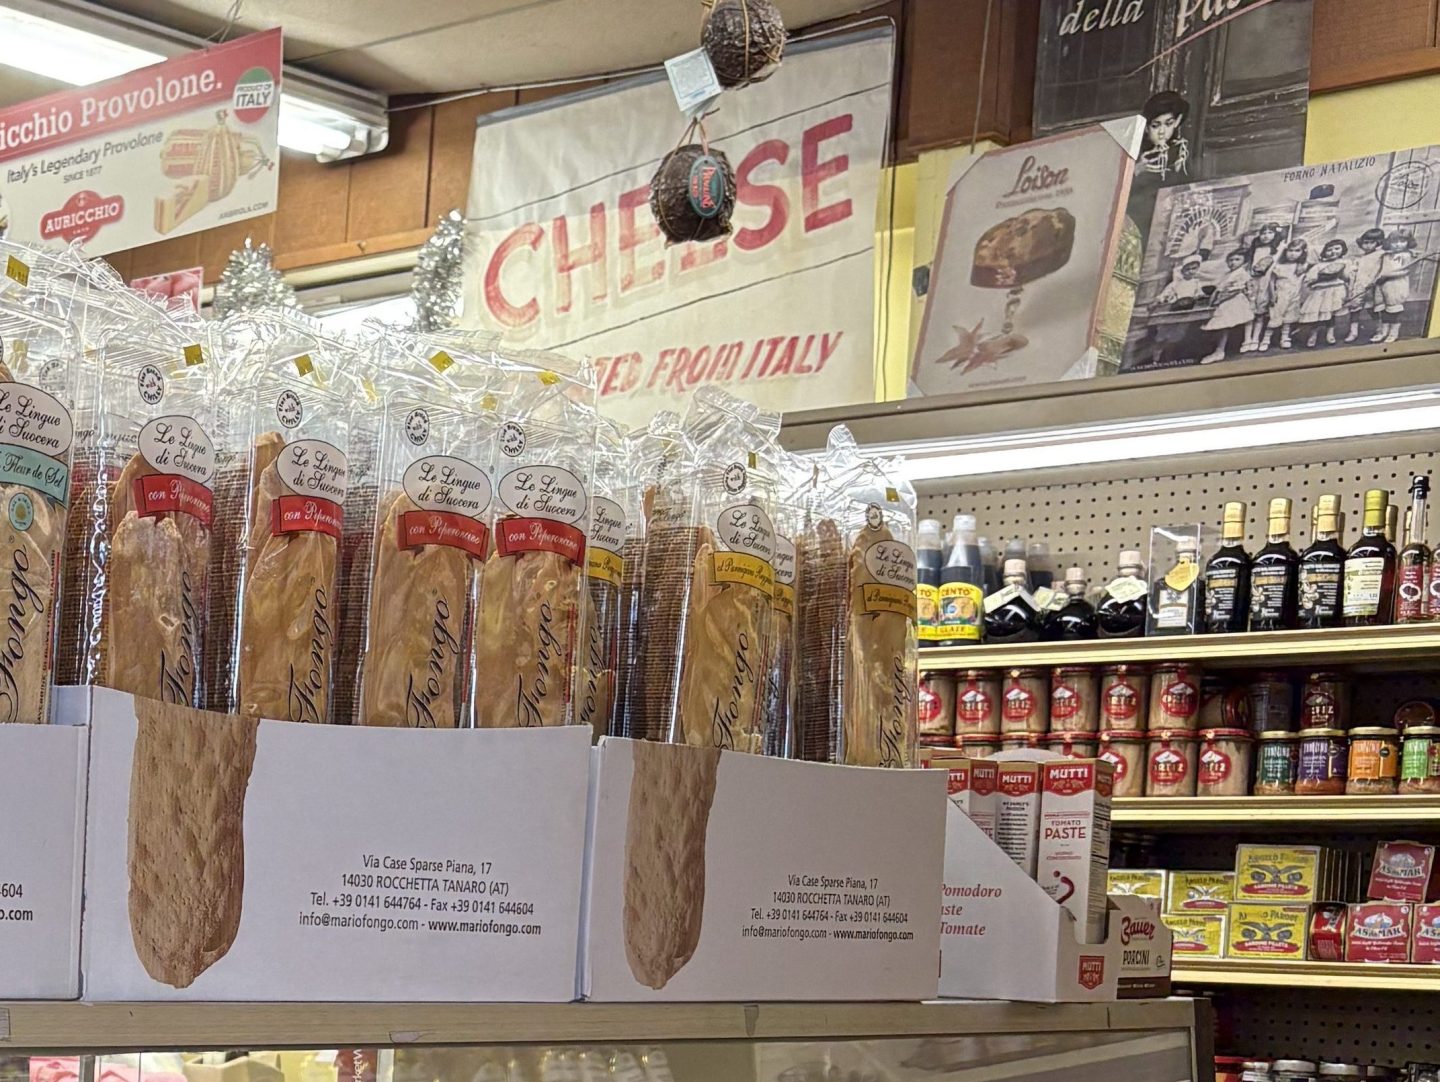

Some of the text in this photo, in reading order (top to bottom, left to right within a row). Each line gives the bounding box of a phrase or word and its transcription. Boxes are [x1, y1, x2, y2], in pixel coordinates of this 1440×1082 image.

[80, 69, 222, 126] Provolone.
[235, 91, 272, 108] ITALY
[7, 130, 164, 184] Italy's Legendary Provolone
[63, 172, 84, 184] SINCE
[1002, 155, 1069, 198] Loison
[1284, 168, 1315, 182] FORNO
[44, 202, 120, 234] AURICCHIO
[483, 113, 853, 328] CHESE
[648, 339, 740, 393] FROM
[739, 331, 844, 379] ITALY
[15, 396, 61, 429] Lingue
[9, 417, 60, 449] Suocera
[3, 452, 31, 478] Fleur
[441, 466, 481, 494] Lingue
[539, 475, 577, 501] Lingue
[434, 489, 479, 510] Suocera
[534, 497, 576, 517] Suocera
[942, 587, 970, 596] CENTO
[973, 768, 994, 779] MUTTI
[1002, 774, 1032, 784] MUTTI
[1050, 764, 1088, 779] MUTTI
[1044, 827, 1087, 840] PASTE
[363, 854, 492, 875] Via Case Sparse Piana, 17
[342, 874, 509, 897] 14030 ROCCHETTA TANARO (AT)
[788, 874, 878, 890] Via Case Sparse Piana, 17
[311, 892, 534, 915] Tel. +39 0141 644764 Fax +39 0141 644604
[773, 892, 890, 908] 14030 ROCCHETTA TANARO (AT)
[299, 912, 541, 936] info@mariofongo.com www.mariofongo.com
[751, 908, 908, 924] Tel. +39 0141 644764 Fax +39 0141 644604
[742, 925, 913, 942] info@mariofongo.com www.mariofongo.com
[1121, 916, 1155, 945] Bauer
[1123, 950, 1150, 965] PORCINI
